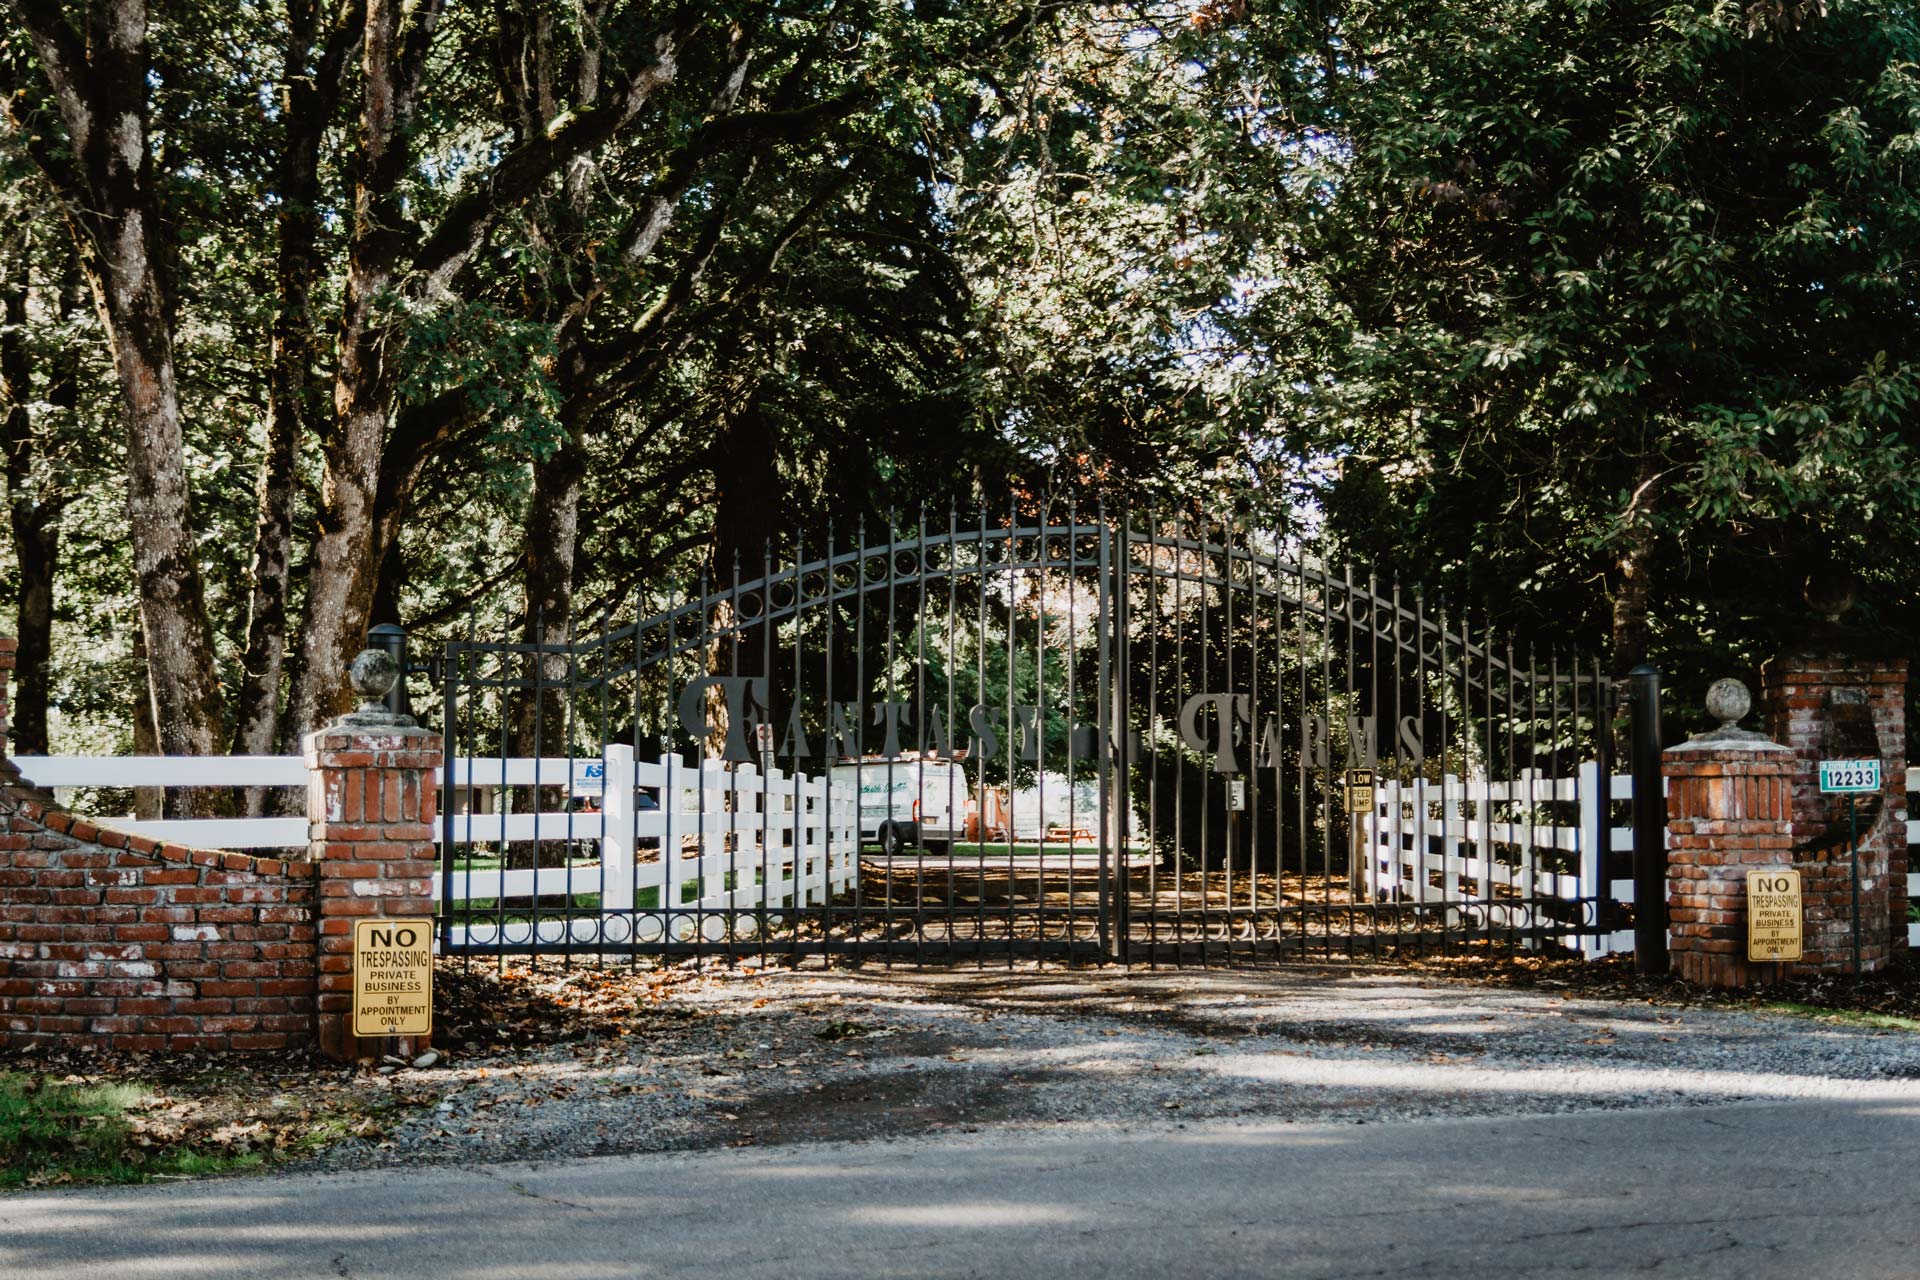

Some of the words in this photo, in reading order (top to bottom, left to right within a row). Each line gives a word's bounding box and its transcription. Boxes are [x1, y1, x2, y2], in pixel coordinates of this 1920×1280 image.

[678, 676, 1045, 761] FANTASY
[1179, 693, 1424, 773] FARMS
[1349, 774, 1371, 784] LOW
[1829, 770, 1874, 787] 12233
[1348, 789, 1371, 798] PEED
[1349, 799, 1370, 808] UMP
[1758, 878, 1790, 893] NO
[1752, 895, 1798, 909] TRESPASSING
[1759, 910, 1791, 918] PRIVATE
[1755, 918, 1795, 927] BUSINESS
[371, 929, 417, 948] NO
[1771, 930, 1780, 938] BY
[1753, 938, 1798, 946] APPOINTMENT
[1766, 945, 1785, 954] ONLY
[360, 951, 428, 968] TRESPASSING
[370, 971, 416, 980] PRIVATE
[365, 982, 421, 992] BUSINESS
[387, 995, 400, 1005] BY
[360, 1006, 427, 1016] APPOINTMENT
[380, 1016, 406, 1026] ONLY
